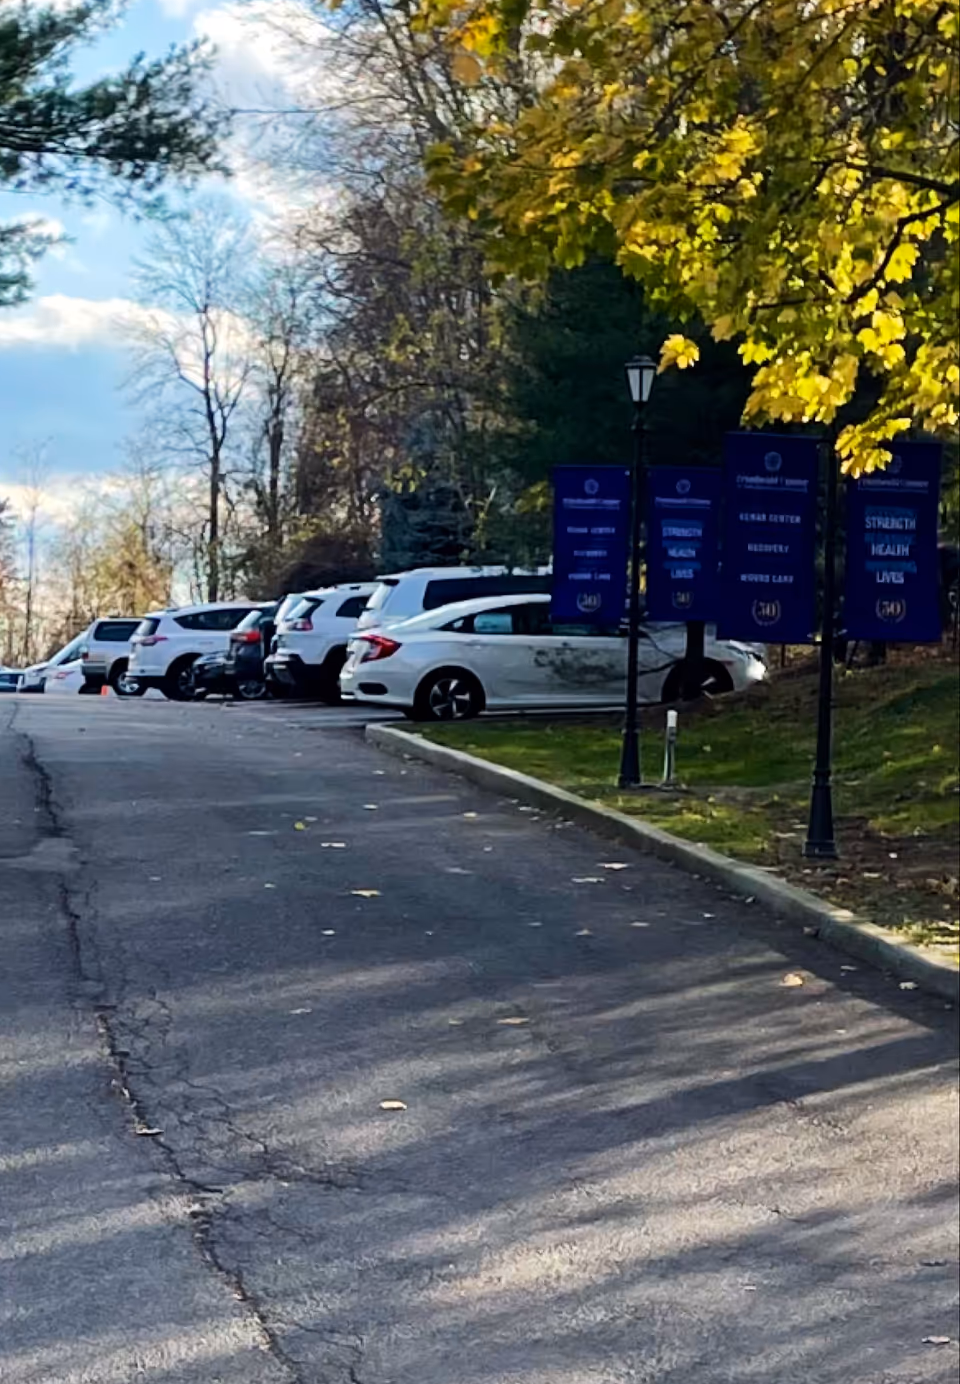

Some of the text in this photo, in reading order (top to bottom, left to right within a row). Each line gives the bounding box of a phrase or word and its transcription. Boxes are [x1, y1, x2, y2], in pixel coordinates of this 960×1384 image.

[864, 516, 916, 530] STRENGTH
[871, 543, 909, 556] HEALTH
[876, 570, 904, 584] LIVES
